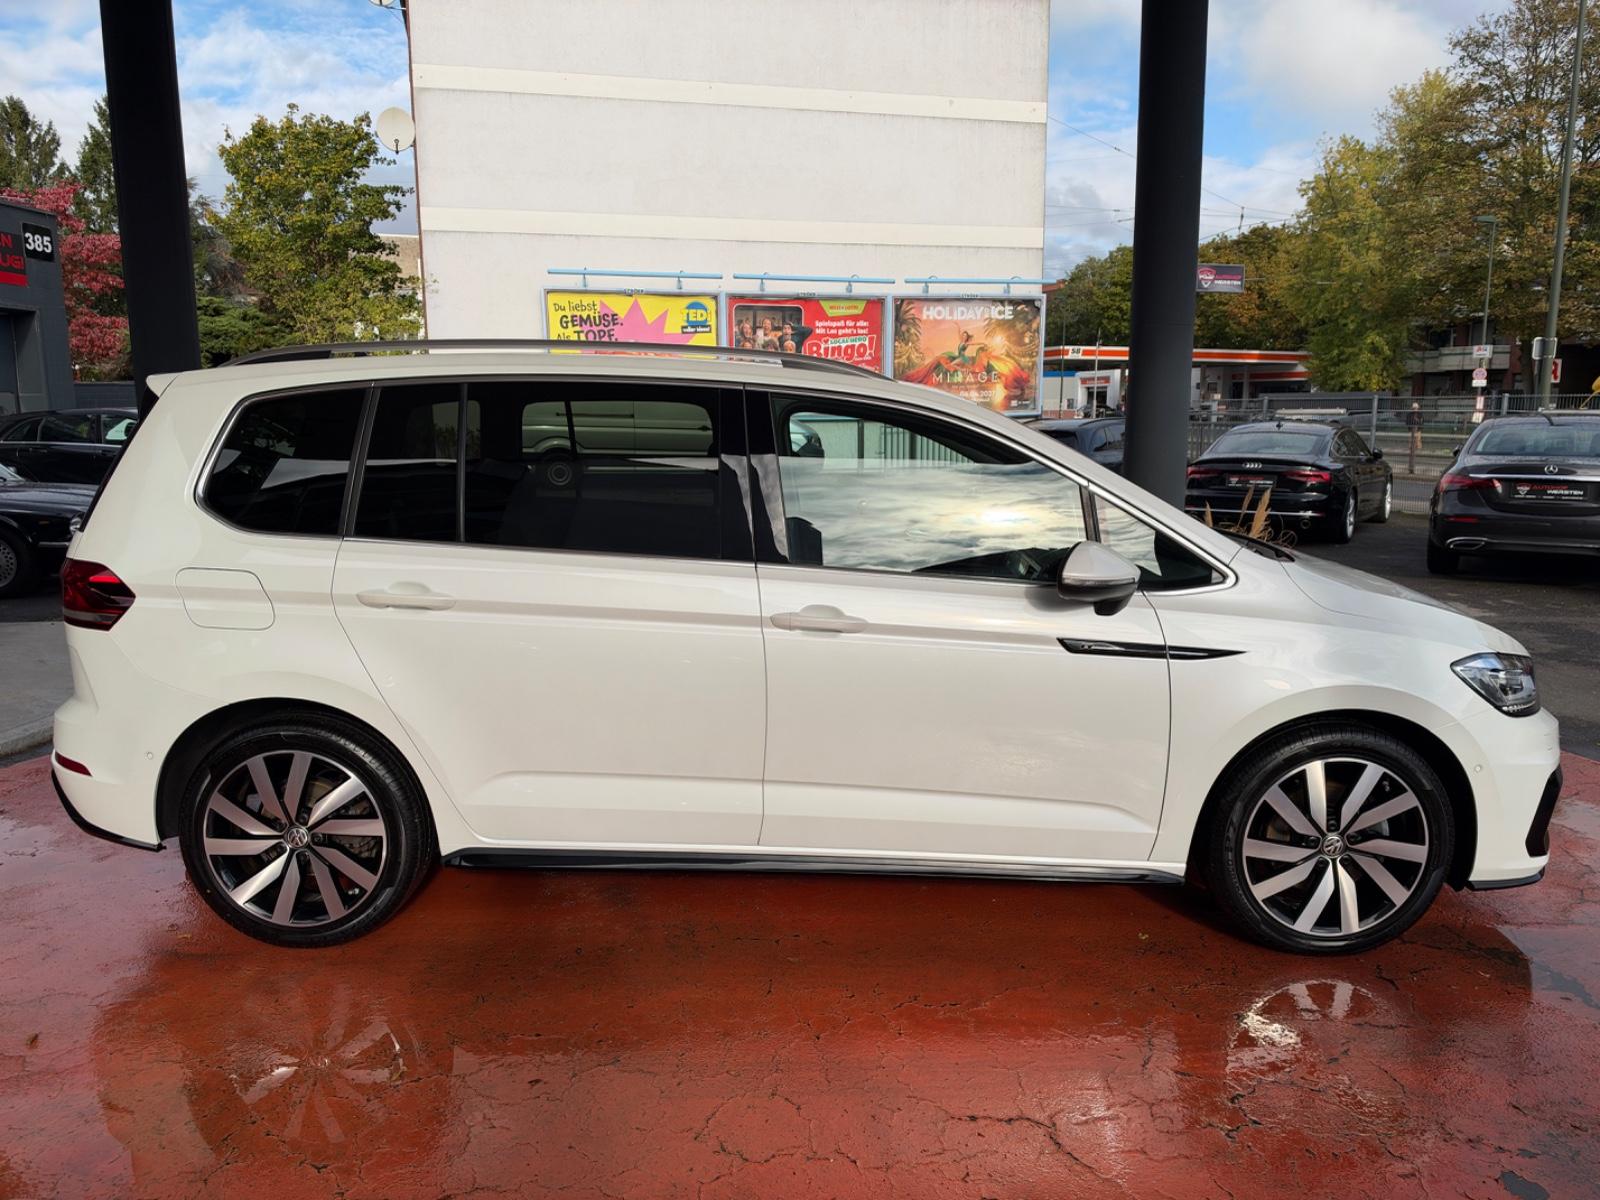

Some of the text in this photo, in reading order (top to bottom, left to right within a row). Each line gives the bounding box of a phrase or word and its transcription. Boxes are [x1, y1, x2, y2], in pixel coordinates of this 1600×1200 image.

[24, 232, 53, 253] 385
[553, 298, 598, 312] Du liebst
[922, 305, 984, 320] HOLIDAY
[991, 304, 1014, 320] ICE
[560, 311, 624, 329] GEMÜSE.
[573, 328, 619, 342] TOPF.
[806, 334, 877, 363] Bingo!
[932, 371, 1000, 384] MIRAGE
